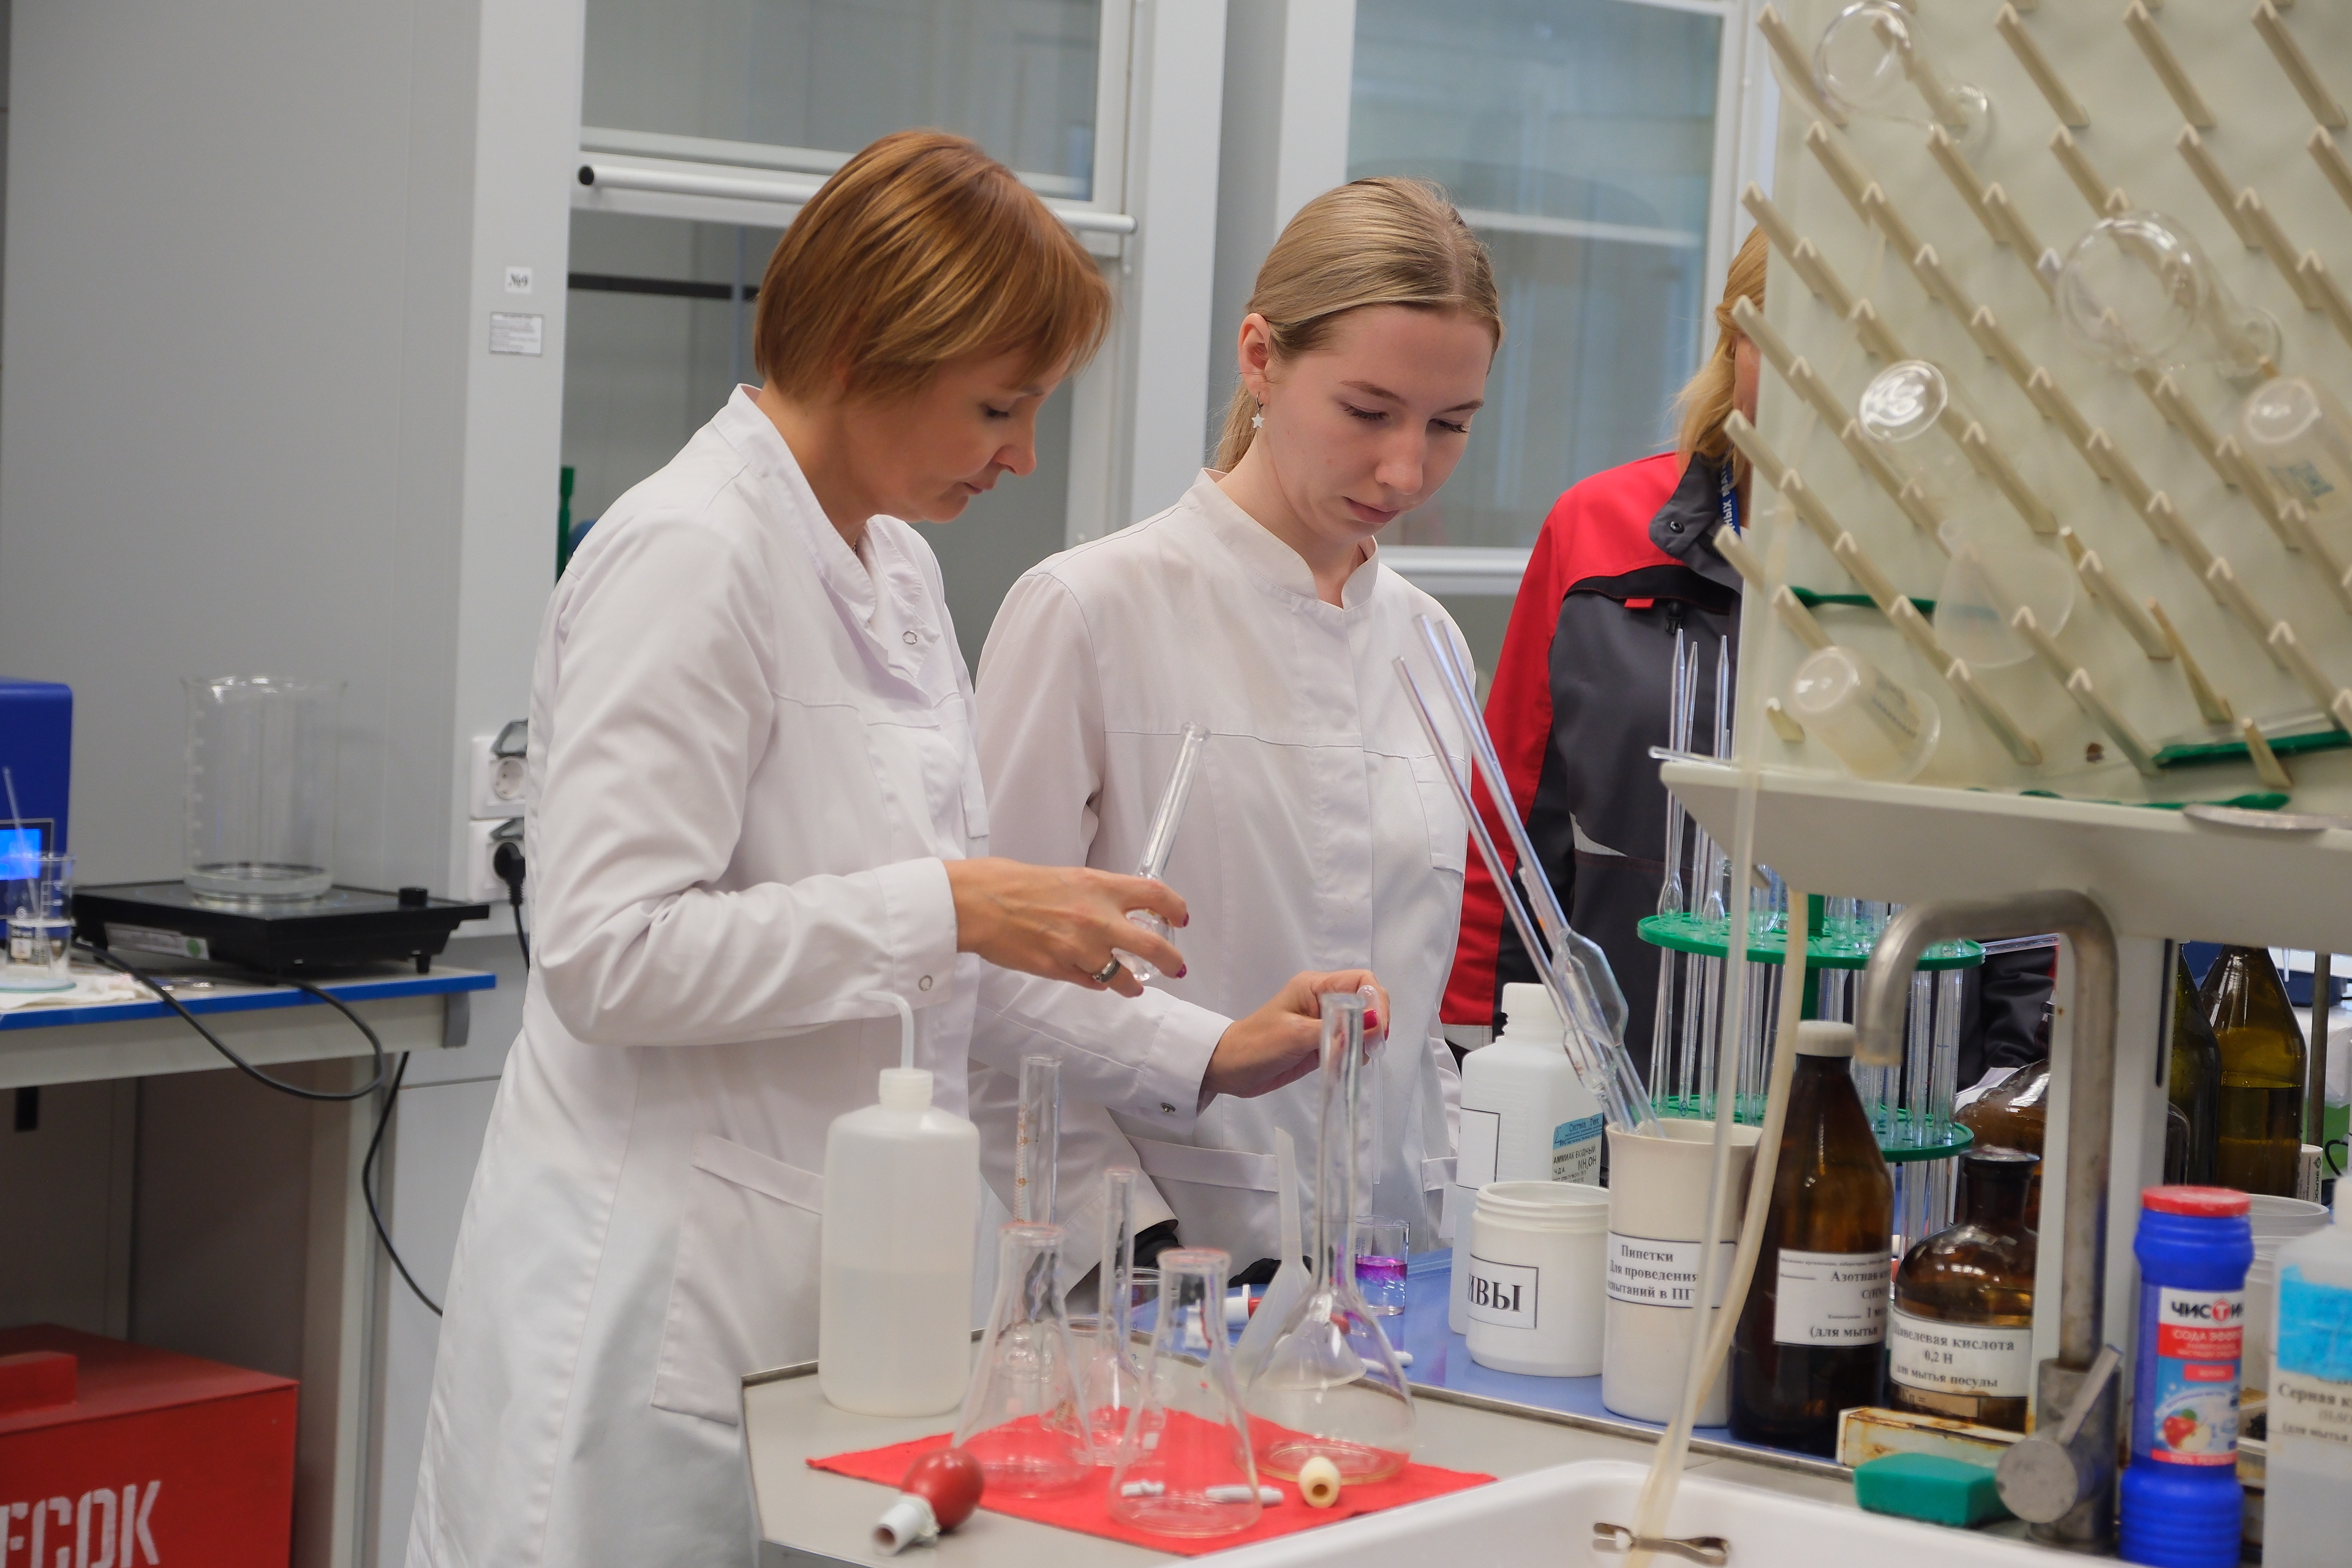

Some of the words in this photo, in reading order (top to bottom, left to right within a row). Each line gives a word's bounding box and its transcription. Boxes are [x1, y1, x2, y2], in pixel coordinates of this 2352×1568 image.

[1553, 1152, 1575, 1164] АММИАК
[1575, 1144, 1596, 1157] ВОДНЫЙ
[1621, 1244, 1674, 1262] Пипетки
[1610, 1259, 1622, 1275] Для
[1624, 1267, 1699, 1283] проведения
[1830, 1271, 1879, 1283] Азотная
[1468, 1273, 1525, 1313] ИВЫ
[1659, 1290, 1668, 1300] в
[2171, 1299, 2245, 1322] ЧИСТИ
[1810, 1325, 1839, 1339] (для
[1843, 1326, 1879, 1338] мытья
[1952, 1338, 2015, 1351] кислота
[1924, 1349, 1940, 1363] 0,2
[1911, 1369, 1947, 1382] мытья
[1950, 1375, 1999, 1390] посуды
